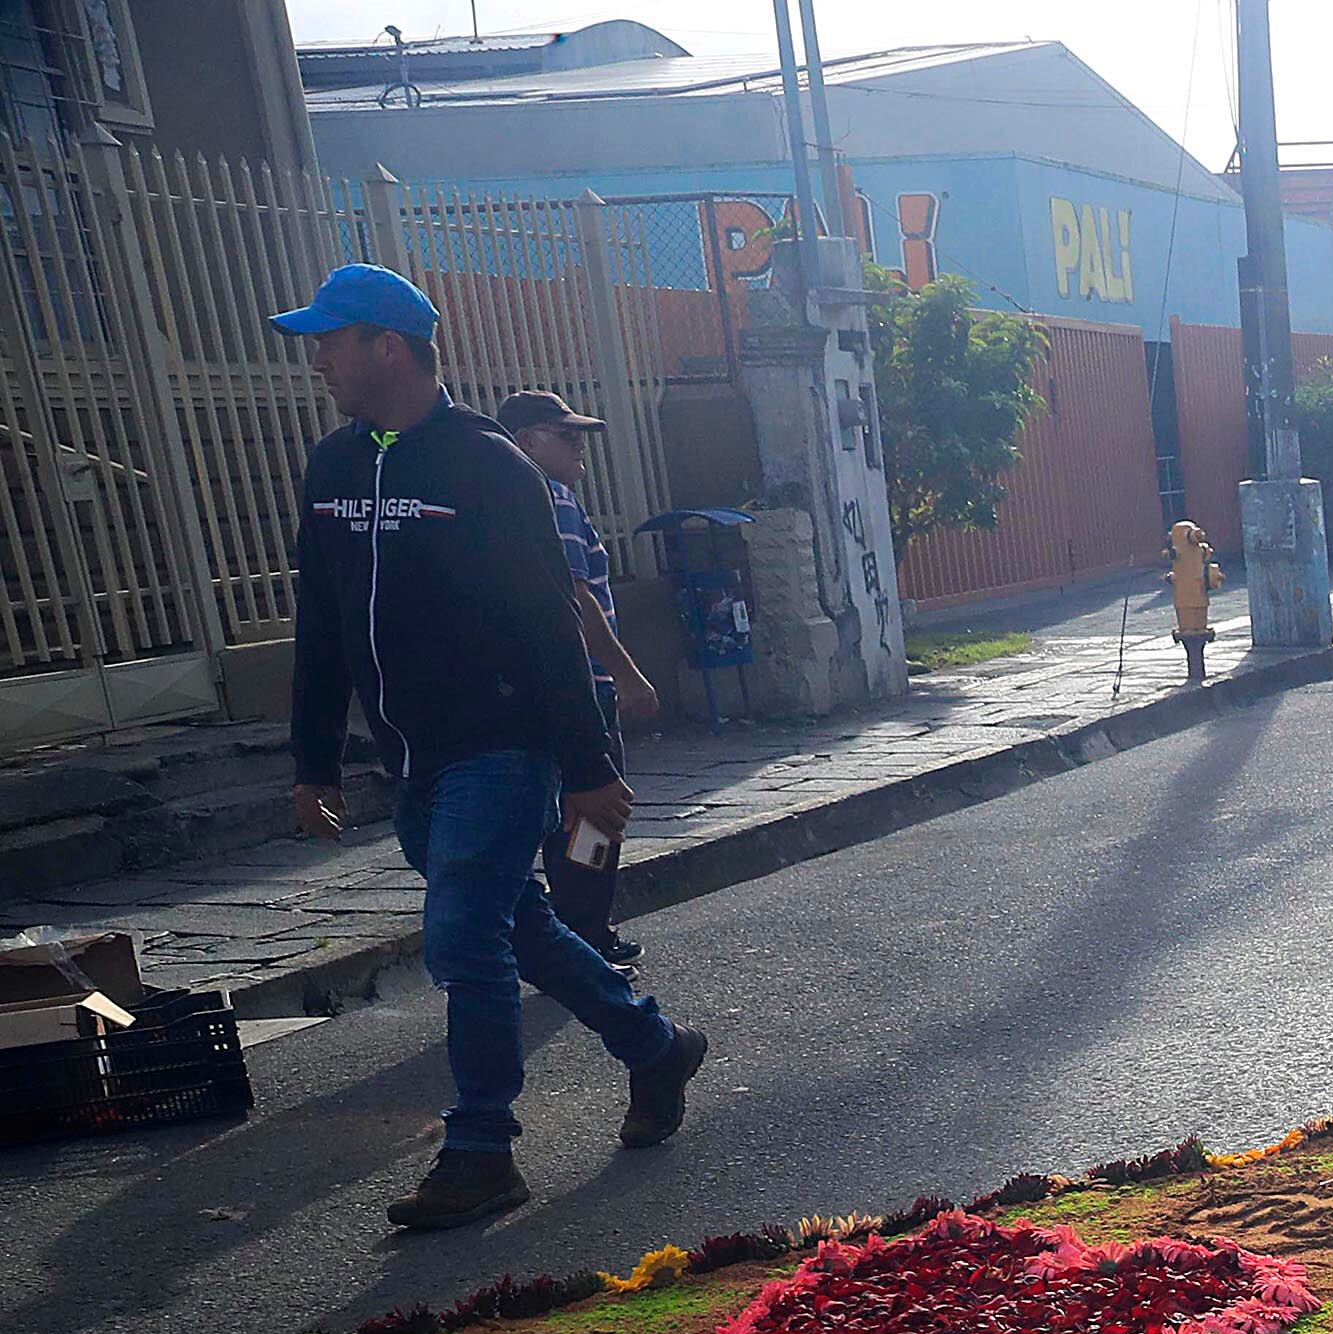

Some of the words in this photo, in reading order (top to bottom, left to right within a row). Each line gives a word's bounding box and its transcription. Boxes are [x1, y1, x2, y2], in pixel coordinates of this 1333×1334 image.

[334, 499, 422, 518] HILFIGER
[351, 521, 369, 532] NEW
[380, 520, 400, 531] YORK
